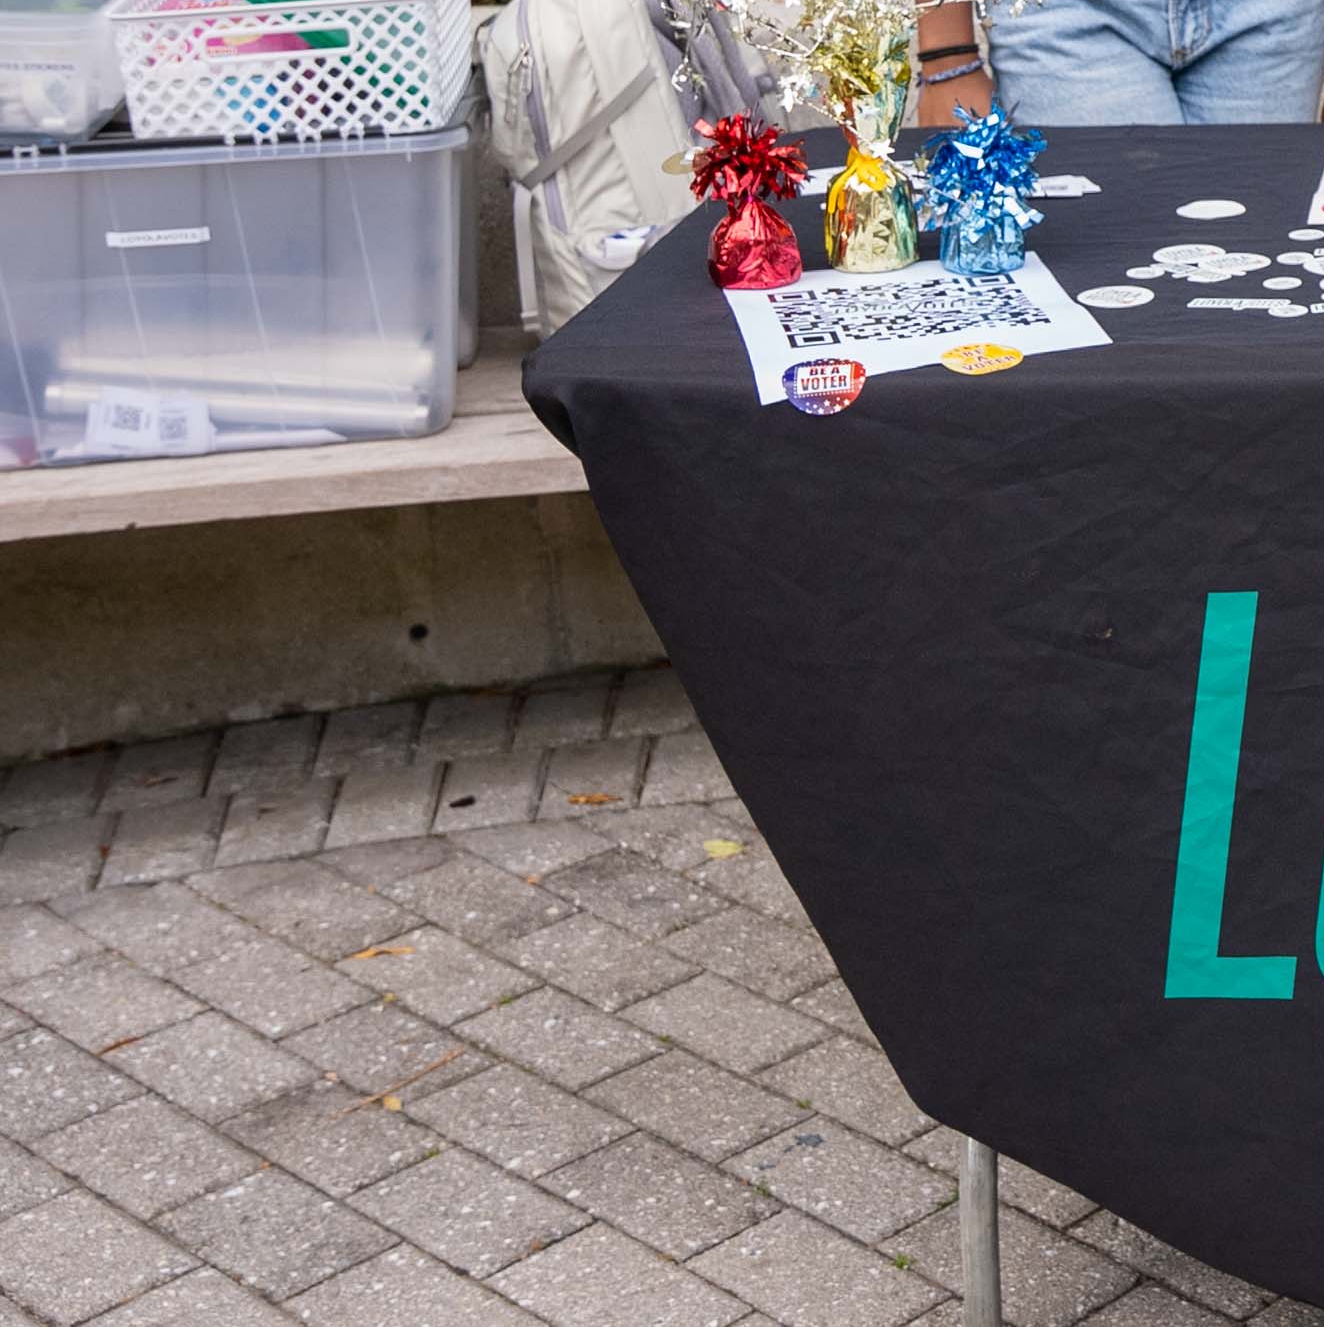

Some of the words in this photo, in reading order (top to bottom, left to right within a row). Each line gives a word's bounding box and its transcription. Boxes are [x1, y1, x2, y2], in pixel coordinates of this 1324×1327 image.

[809, 367, 827, 376] BE
[830, 365, 841, 375] A
[962, 356, 1017, 372] VOTER
[800, 376, 848, 392] VOTER
